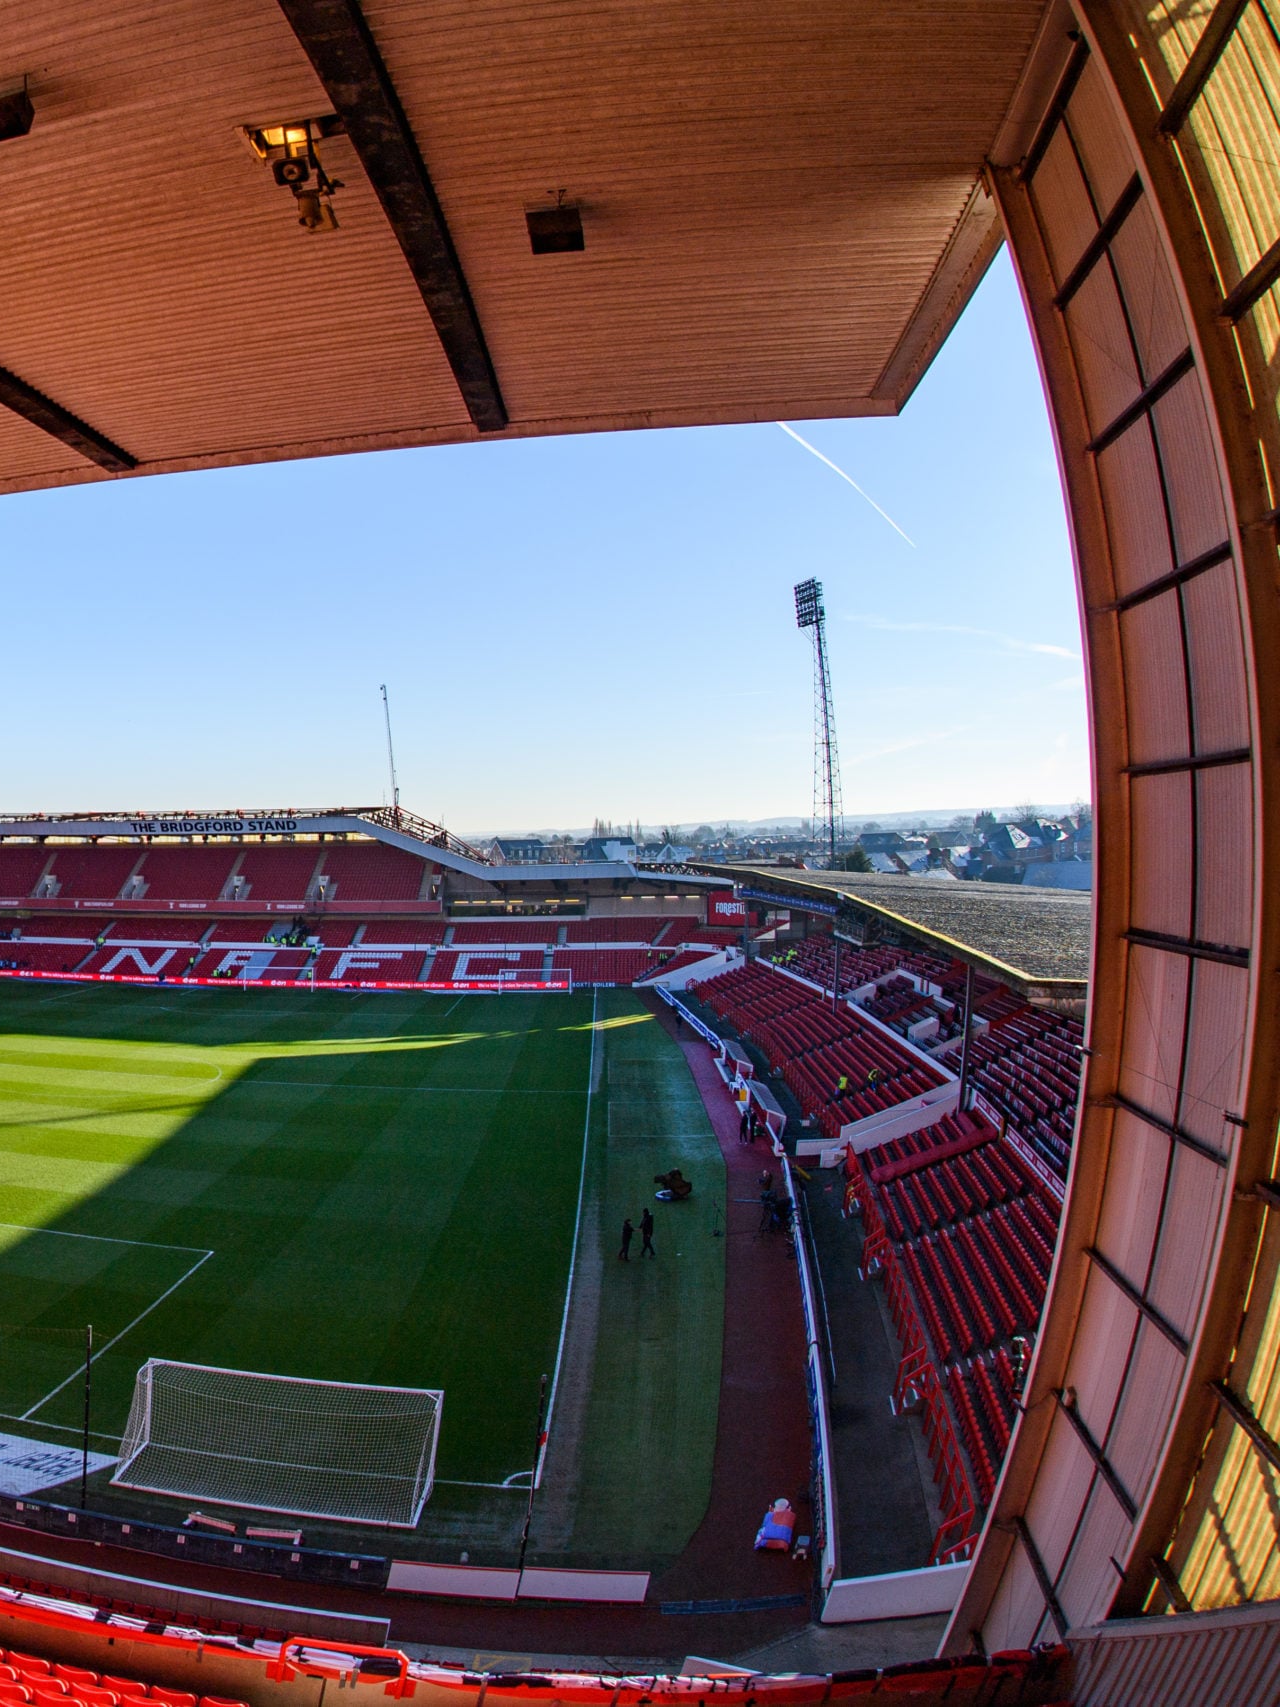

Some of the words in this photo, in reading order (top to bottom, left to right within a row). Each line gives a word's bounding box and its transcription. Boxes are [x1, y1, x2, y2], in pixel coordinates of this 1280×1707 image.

[131, 822, 156, 833] THE
[160, 821, 244, 832] BRIDGFORD
[248, 820, 297, 831] STAND
